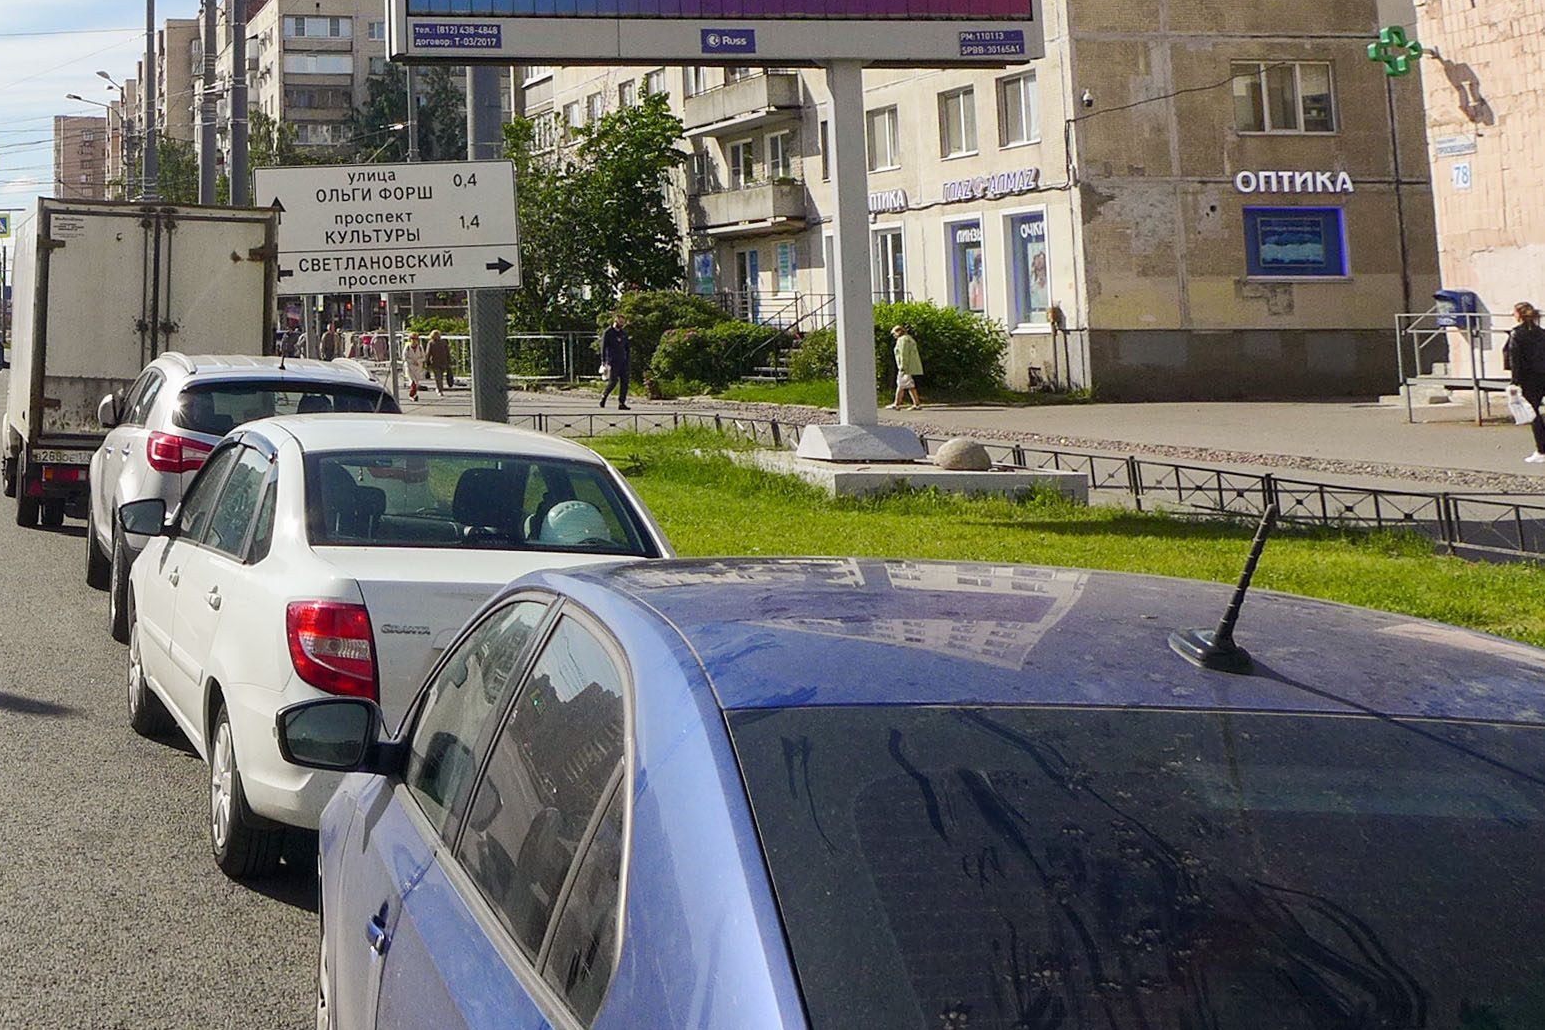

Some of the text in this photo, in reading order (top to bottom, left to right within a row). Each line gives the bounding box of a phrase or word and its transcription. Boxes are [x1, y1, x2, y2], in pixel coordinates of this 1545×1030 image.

[436, 25, 458, 35] (812)
[722, 35, 747, 46] Russ
[347, 170, 478, 188] улица 0,4
[1235, 170, 1355, 193] ОПТИКА
[1454, 165, 1469, 185] 78
[315, 185, 433, 203] ОЛЬГИ ФОРШ
[868, 189, 906, 211] ПТИКА
[334, 211, 481, 230] проспект 1,4
[324, 228, 421, 245] КУЛЬТУРЫ
[298, 251, 454, 272] СВЕТЛАНОВСКИЙ
[338, 273, 417, 289] проспект
